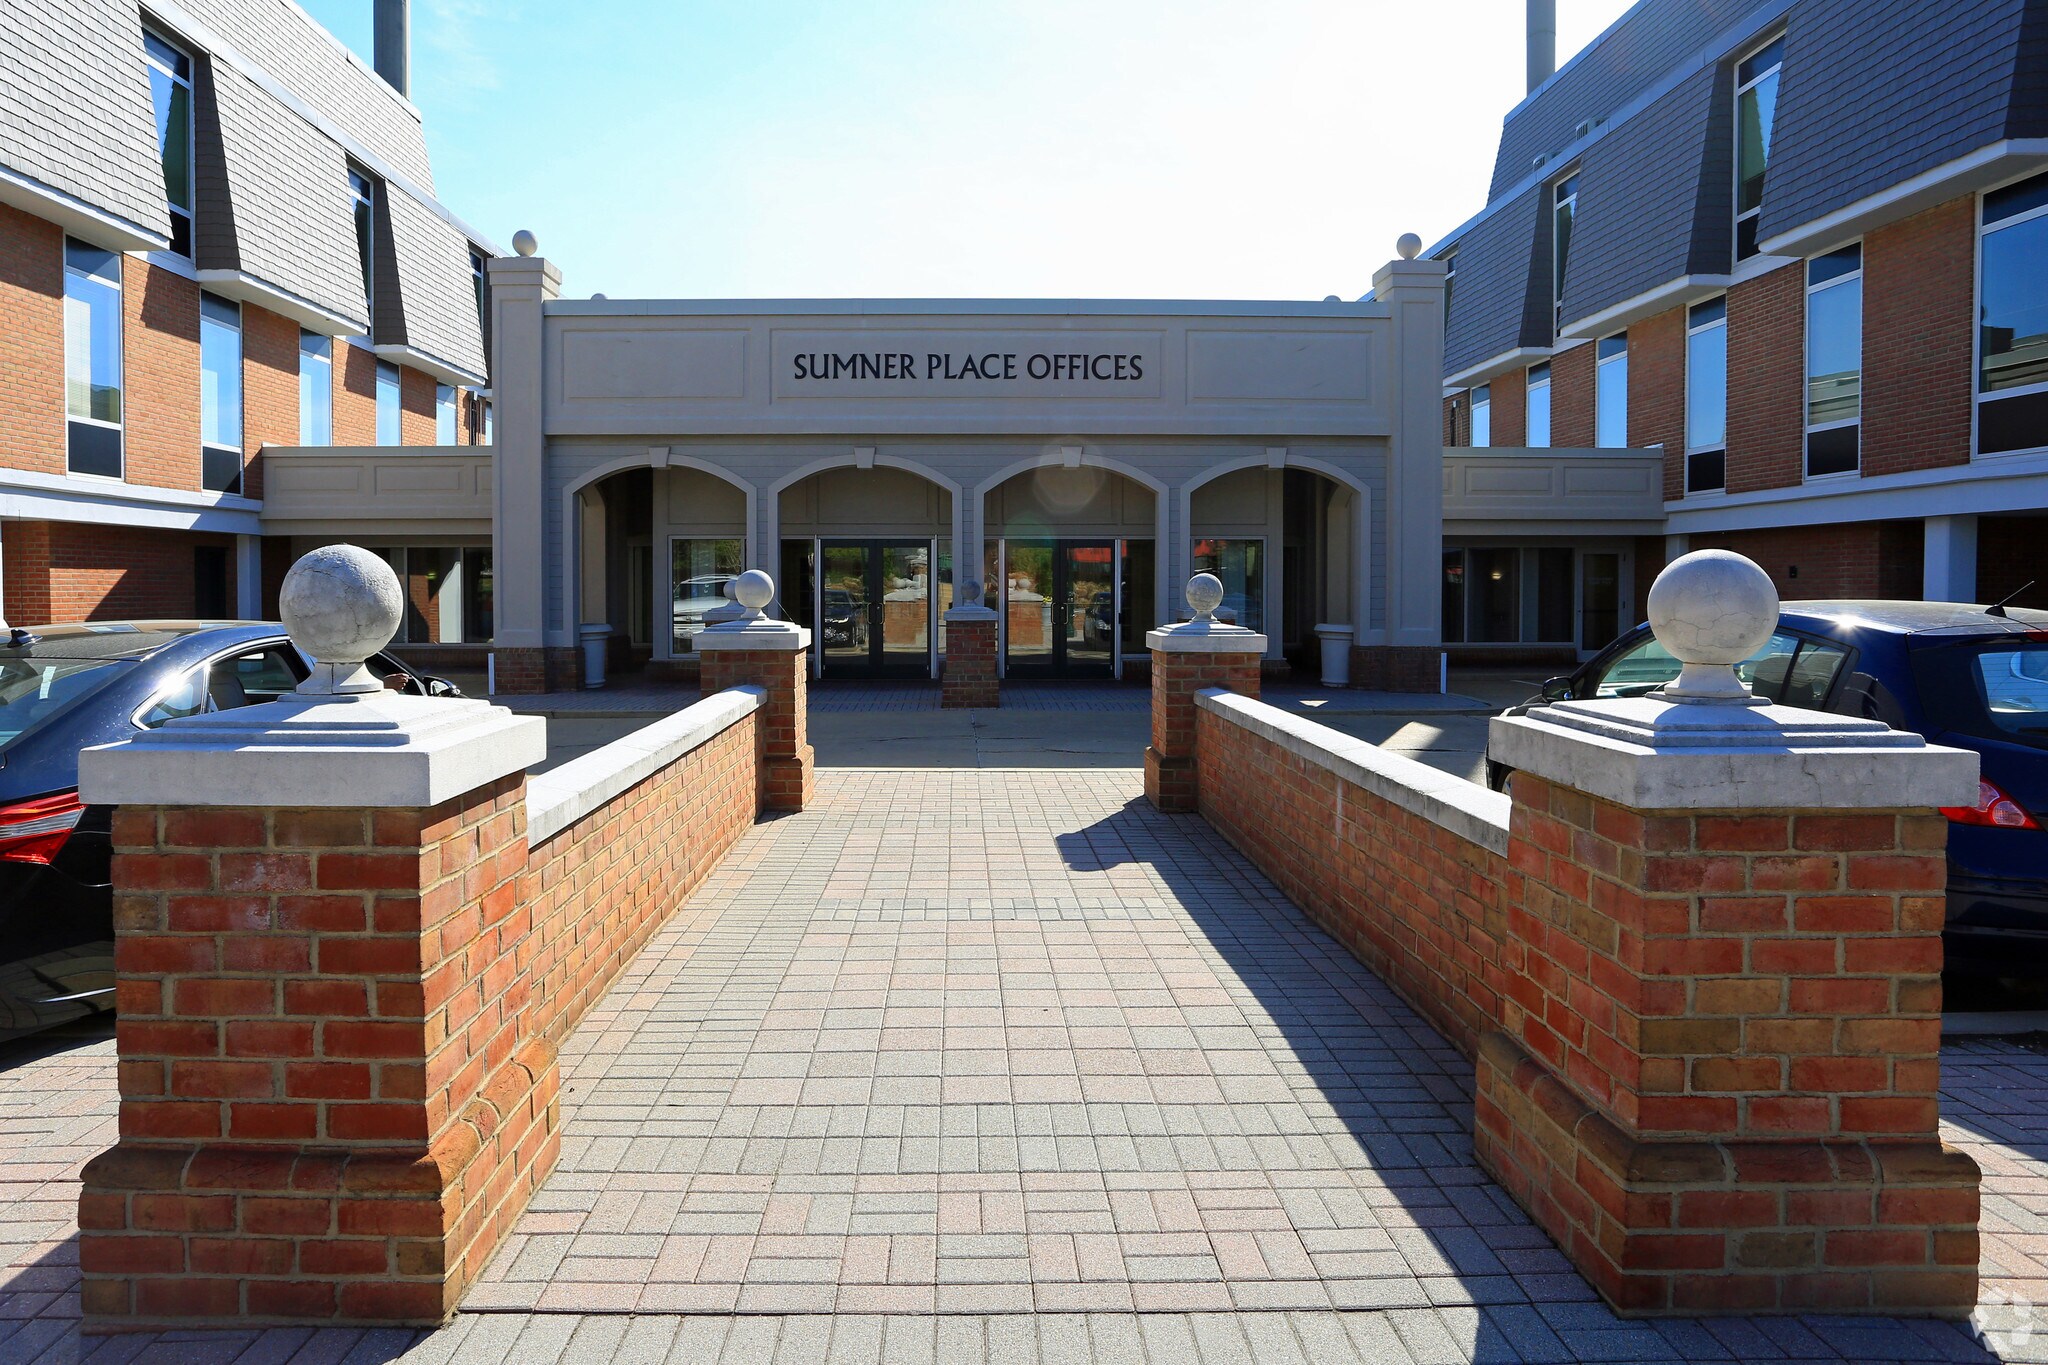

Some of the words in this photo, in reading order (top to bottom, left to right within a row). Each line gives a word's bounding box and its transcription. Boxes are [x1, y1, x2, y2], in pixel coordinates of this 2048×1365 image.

[793, 353, 917, 380] SUMNER
[927, 353, 1018, 380] PLACE
[1026, 354, 1143, 381] OFFICES
